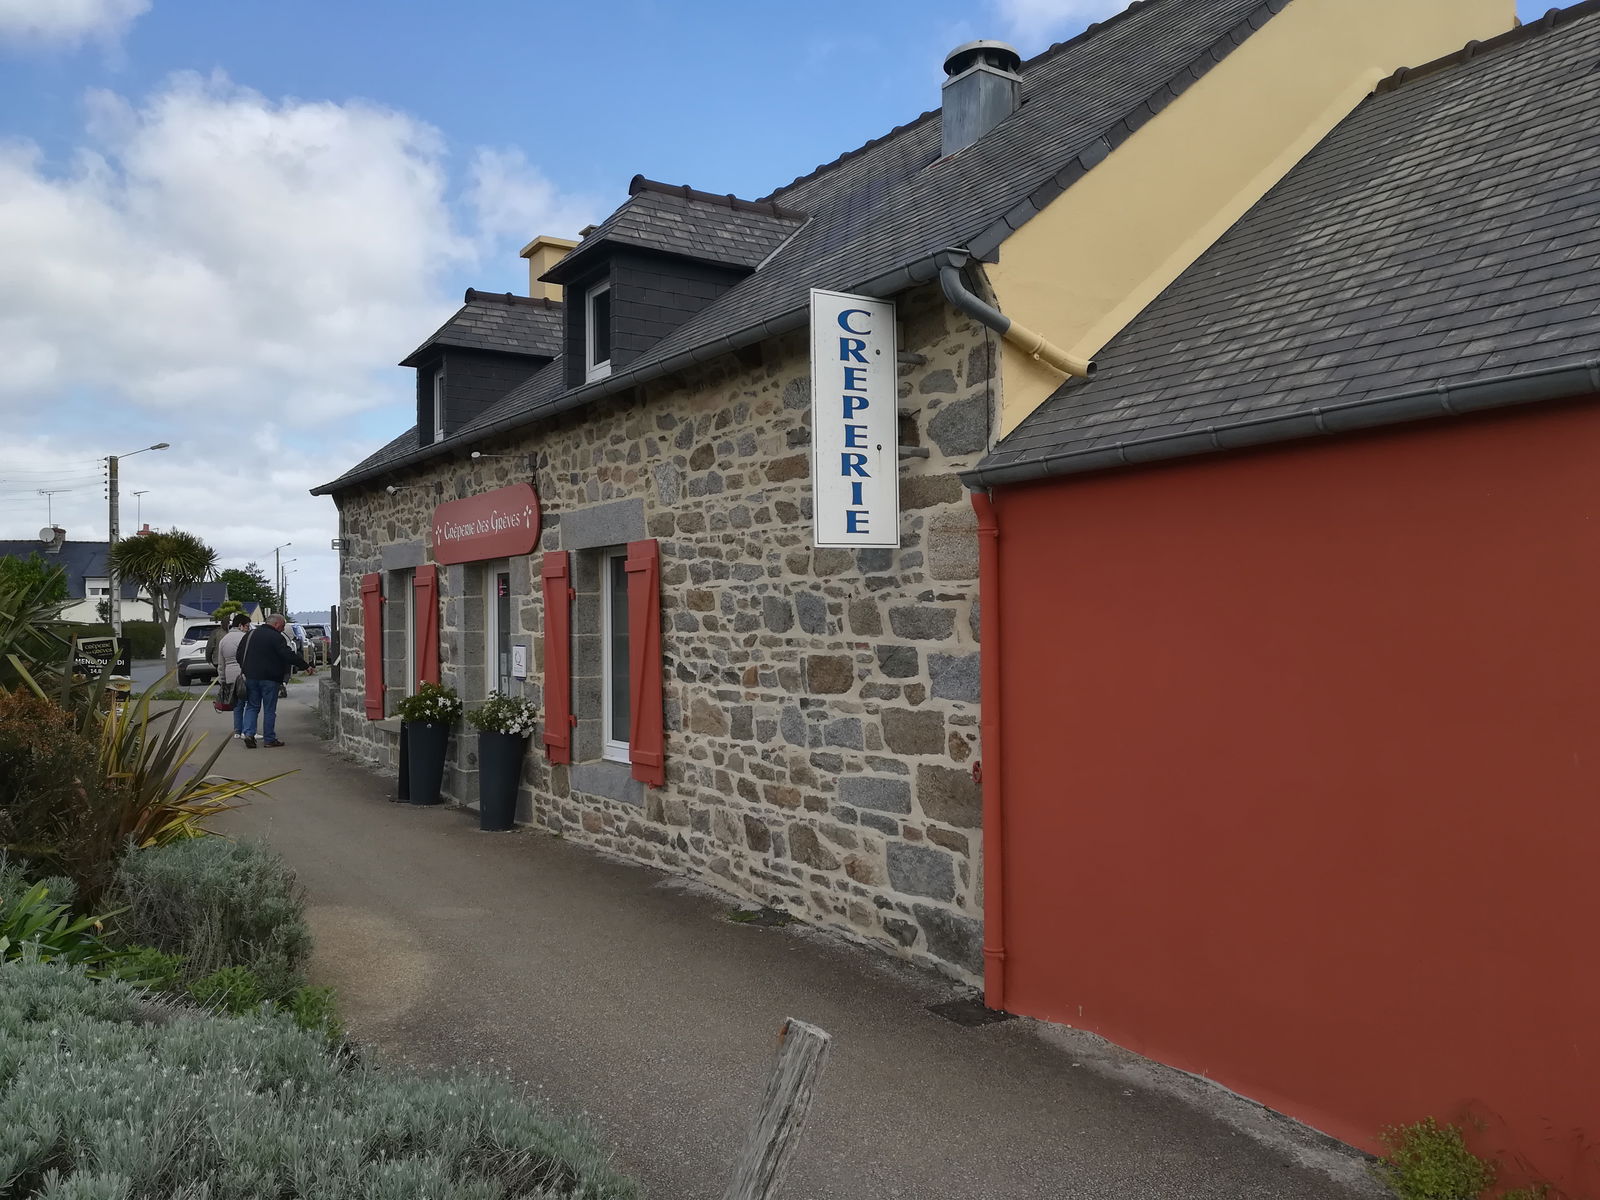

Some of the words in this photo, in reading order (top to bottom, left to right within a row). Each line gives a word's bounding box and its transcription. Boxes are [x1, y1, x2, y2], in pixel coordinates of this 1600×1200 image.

[837, 309, 872, 534] CREPERIE
[476, 519, 490, 534] des
[491, 510, 520, 534] Grèves
